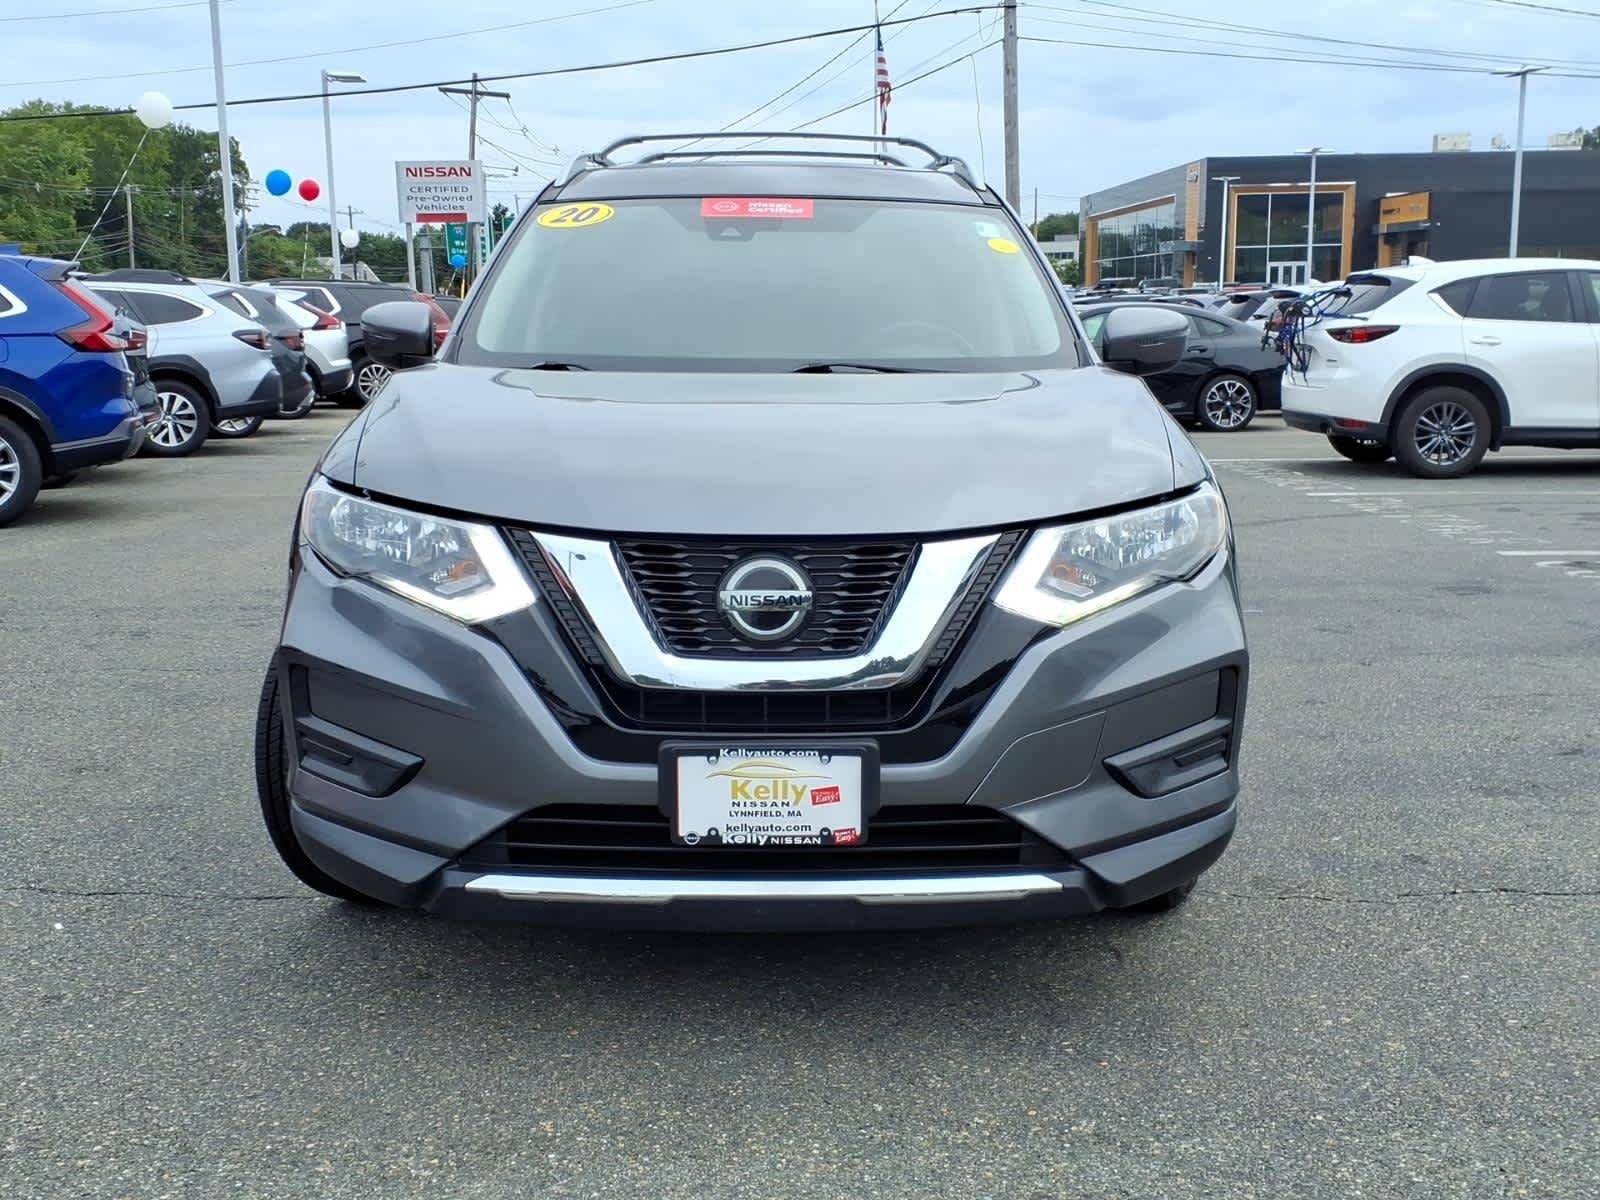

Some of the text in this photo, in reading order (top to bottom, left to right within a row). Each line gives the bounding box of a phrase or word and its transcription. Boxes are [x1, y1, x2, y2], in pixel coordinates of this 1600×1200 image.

[405, 167, 471, 177] NISSAN
[416, 203, 465, 211] Vehicles
[549, 207, 600, 223] 20
[729, 595, 802, 606] NISSAN
[719, 748, 819, 758] Kellyauto.com
[731, 779, 808, 805] Kelly
[729, 810, 785, 818] LYNNFIELD,
[726, 823, 812, 834] kellyauto.com
[721, 832, 821, 846] Kelly NISSAN
